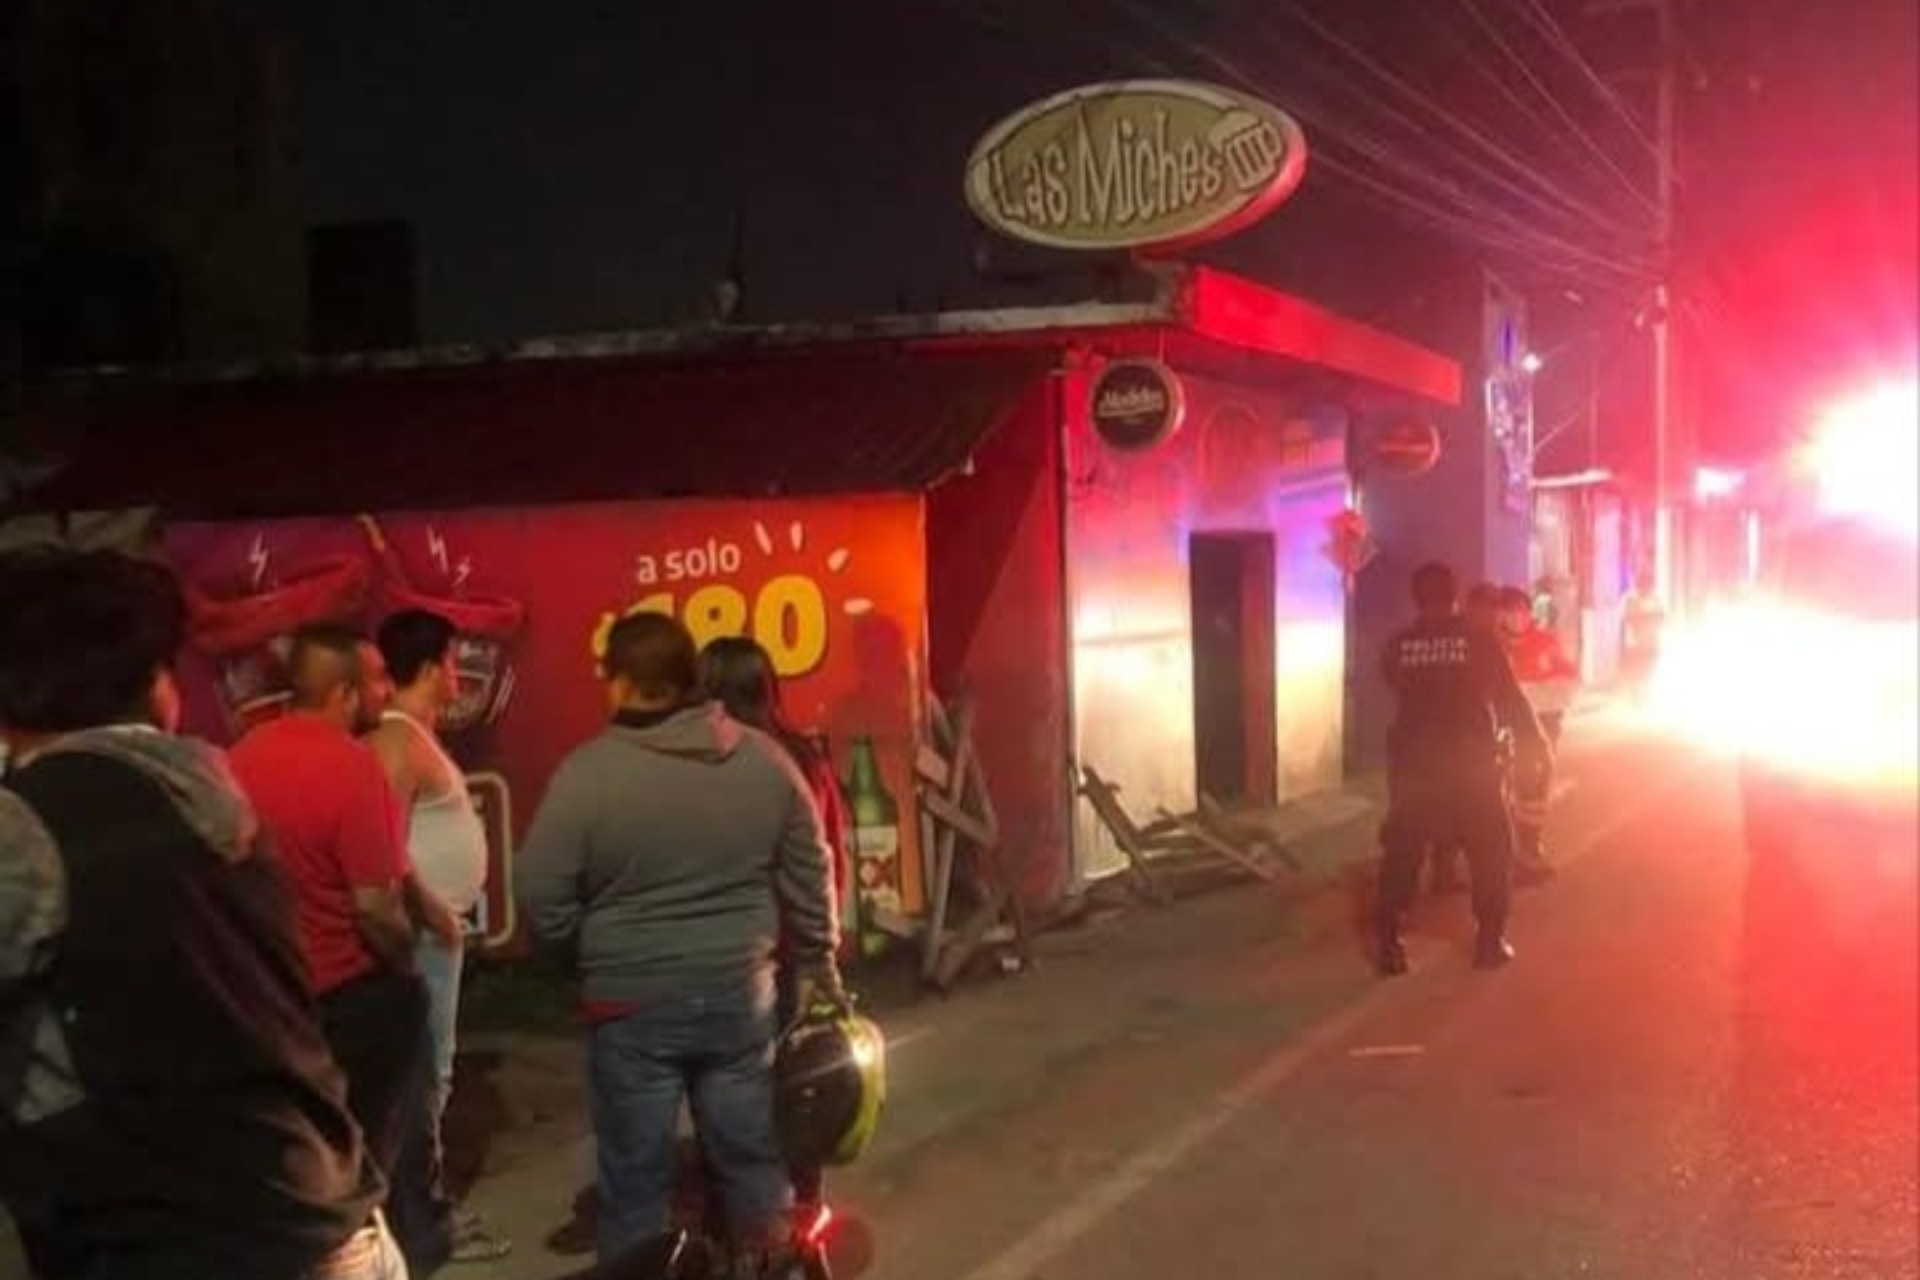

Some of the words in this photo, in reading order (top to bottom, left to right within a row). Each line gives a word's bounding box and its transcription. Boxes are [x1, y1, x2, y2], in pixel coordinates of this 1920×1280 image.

[990, 143, 1069, 228] Las
[1072, 103, 1226, 229] Miches
[637, 555, 656, 584] a
[665, 537, 741, 580] solo
